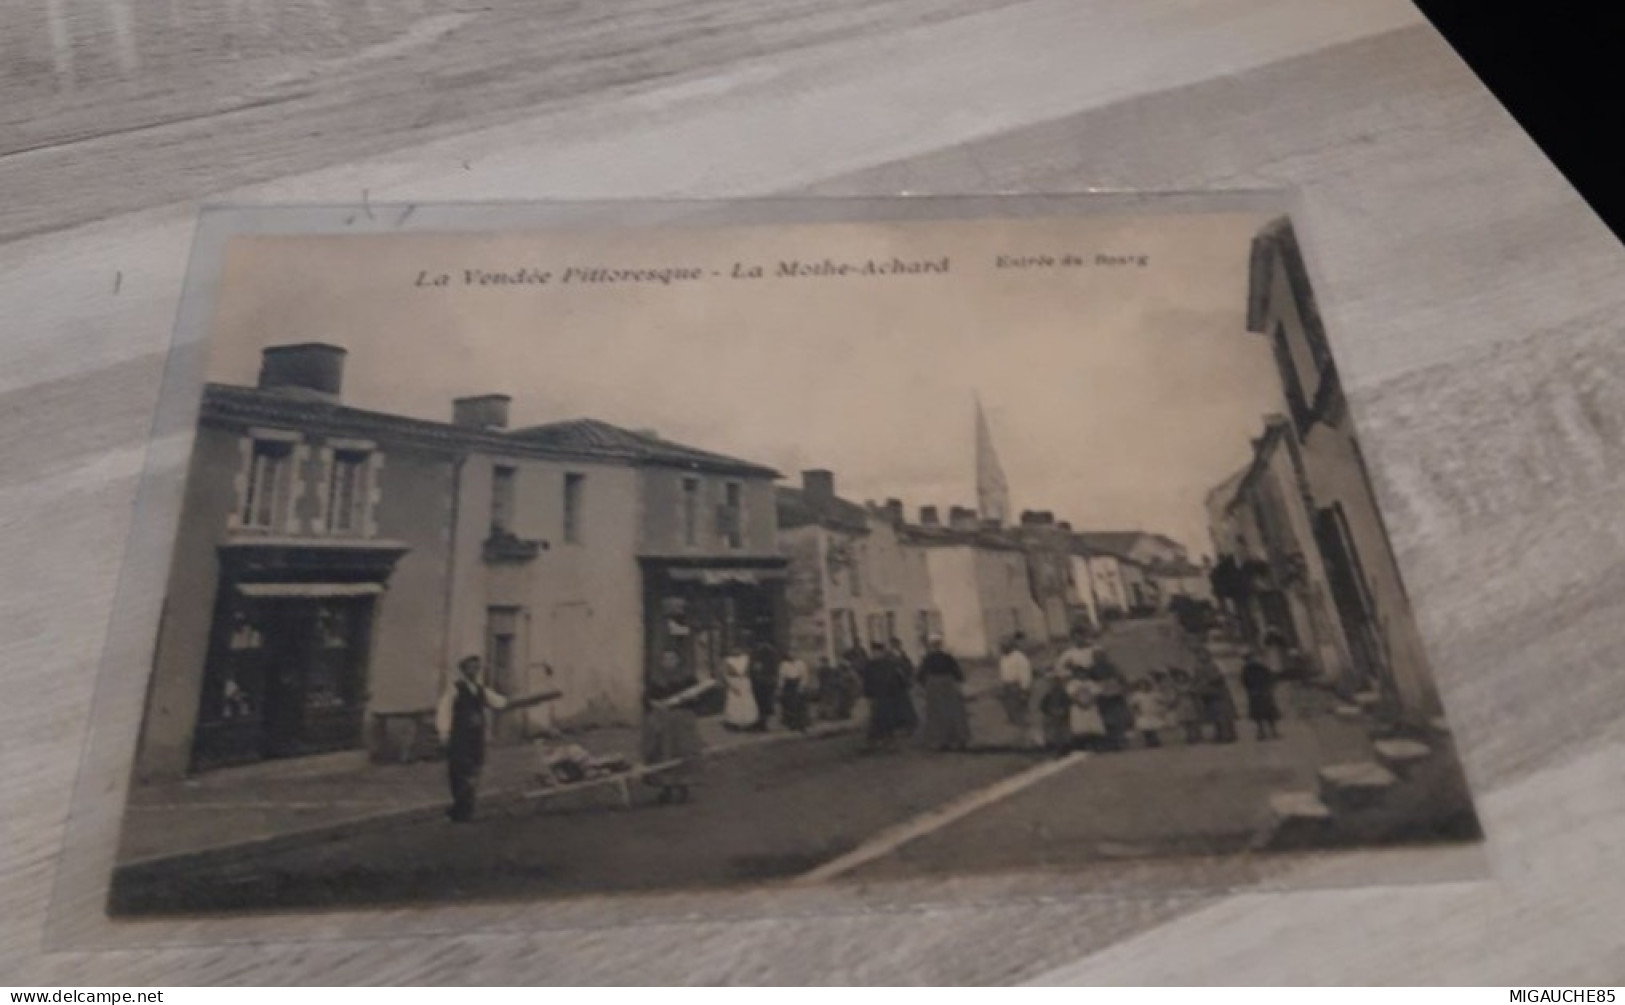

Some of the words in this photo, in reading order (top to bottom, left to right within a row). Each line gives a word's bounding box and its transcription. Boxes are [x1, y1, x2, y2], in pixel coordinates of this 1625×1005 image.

[414, 269, 449, 287] La
[463, 267, 552, 286] Vendée
[560, 266, 703, 286] Pittoresque
[731, 261, 764, 279] La
[775, 255, 950, 278] Mothe-Achard
